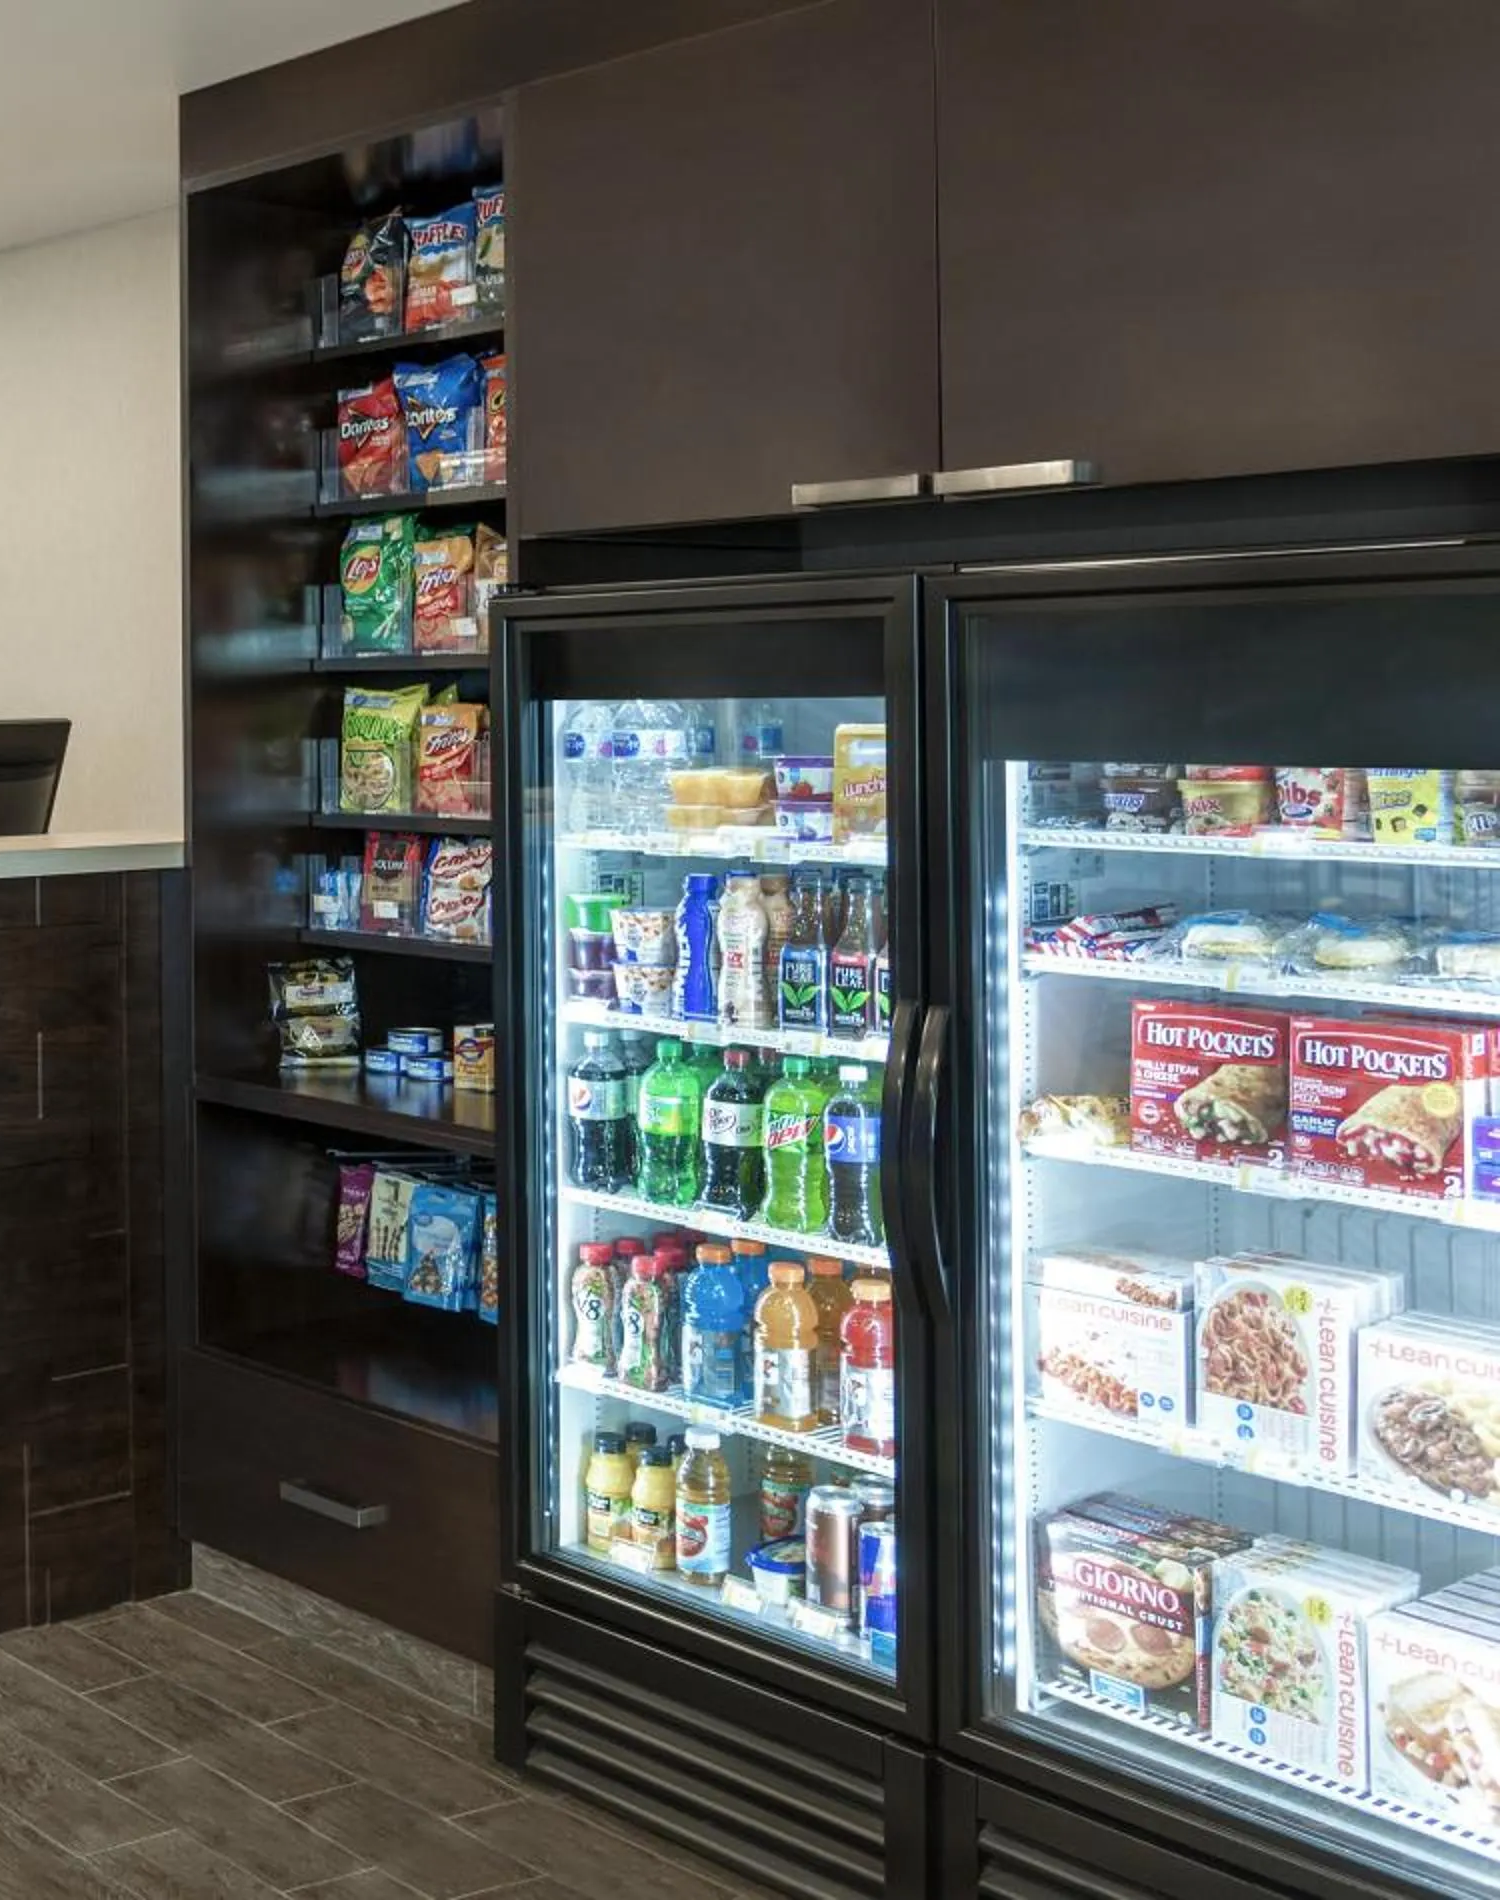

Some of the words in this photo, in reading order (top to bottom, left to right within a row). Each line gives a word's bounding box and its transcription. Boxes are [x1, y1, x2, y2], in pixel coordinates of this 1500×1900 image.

[341, 416, 389, 439] Doritos
[1146, 1022, 1185, 1047] HOT
[1188, 1028, 1274, 1059] POCKETS
[1304, 1040, 1349, 1067] HOT
[1350, 1045, 1448, 1079] POCKETS
[1268, 1150, 1284, 1169] 2
[1319, 1377, 1337, 1462] cuisine
[1139, 1609, 1184, 1631] CRUST
